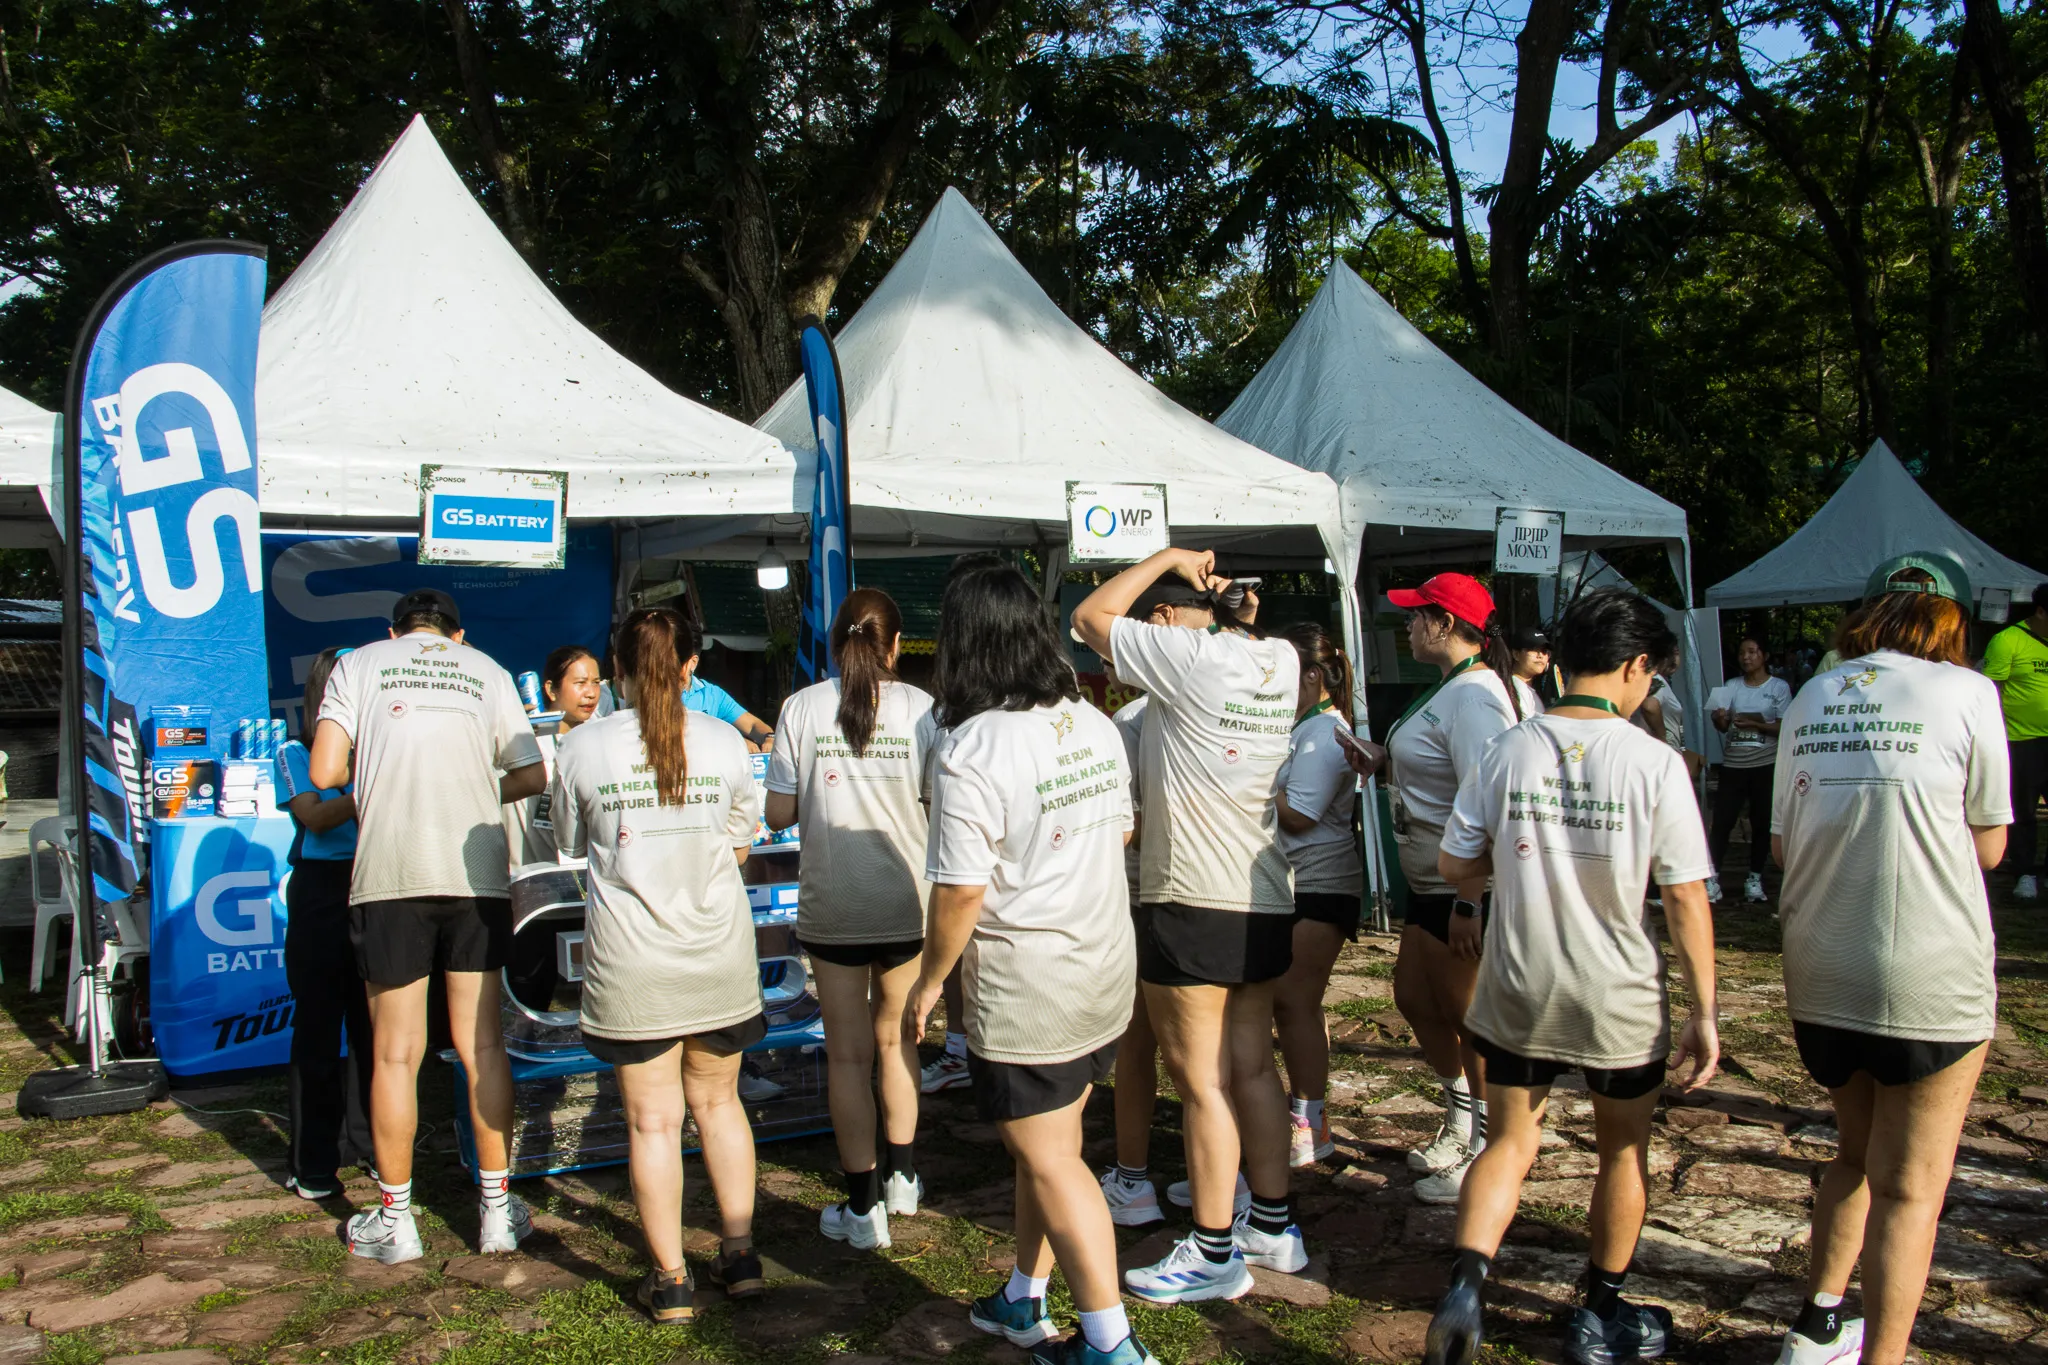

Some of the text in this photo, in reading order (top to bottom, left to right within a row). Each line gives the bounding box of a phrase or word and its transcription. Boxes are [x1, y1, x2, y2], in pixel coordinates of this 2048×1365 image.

[435, 476, 466, 484] SPONSOR
[120, 362, 263, 619] GS
[442, 508, 549, 529] GS BATTERY
[1120, 508, 1153, 527] WP
[1120, 527, 1154, 537] ENERGY
[1511, 526, 1549, 544] JIPJIP
[1506, 543, 1551, 559] MONEY
[452, 579, 520, 589] TECHNOLOGY
[411, 657, 459, 668] WE RUN
[380, 667, 486, 690] WE HEAL NATURE
[380, 680, 484, 702] NATURE HEALS US
[1224, 701, 1244, 714] WE
[1244, 705, 1269, 718] HEAL
[1823, 703, 1883, 716] WE RUN
[165, 728, 185, 738] GS
[1218, 717, 1262, 734] NATURE
[1809, 721, 1850, 735] HEAL
[1852, 720, 1924, 736] NATURE
[815, 735, 912, 747] WE HE NATURE
[1841, 739, 1892, 753] HEALS
[1895, 740, 1919, 754] US
[816, 749, 910, 760] NATURE HEALS US
[1056, 755, 1072, 767] WE
[154, 767, 189, 785] GS
[1035, 779, 1054, 796] WE
[1079, 759, 1117, 779] NATURE
[1542, 775, 1564, 790] WE
[597, 783, 619, 796] WE
[602, 797, 655, 813] NATURE
[705, 793, 720, 804] US
[1041, 791, 1078, 815] NATURE
[1508, 791, 1625, 814] WE HEAL NATURE
[1508, 809, 1624, 832] NATURE HEALS US
[207, 948, 285, 974] BATT
[211, 1004, 293, 1052] TOU
